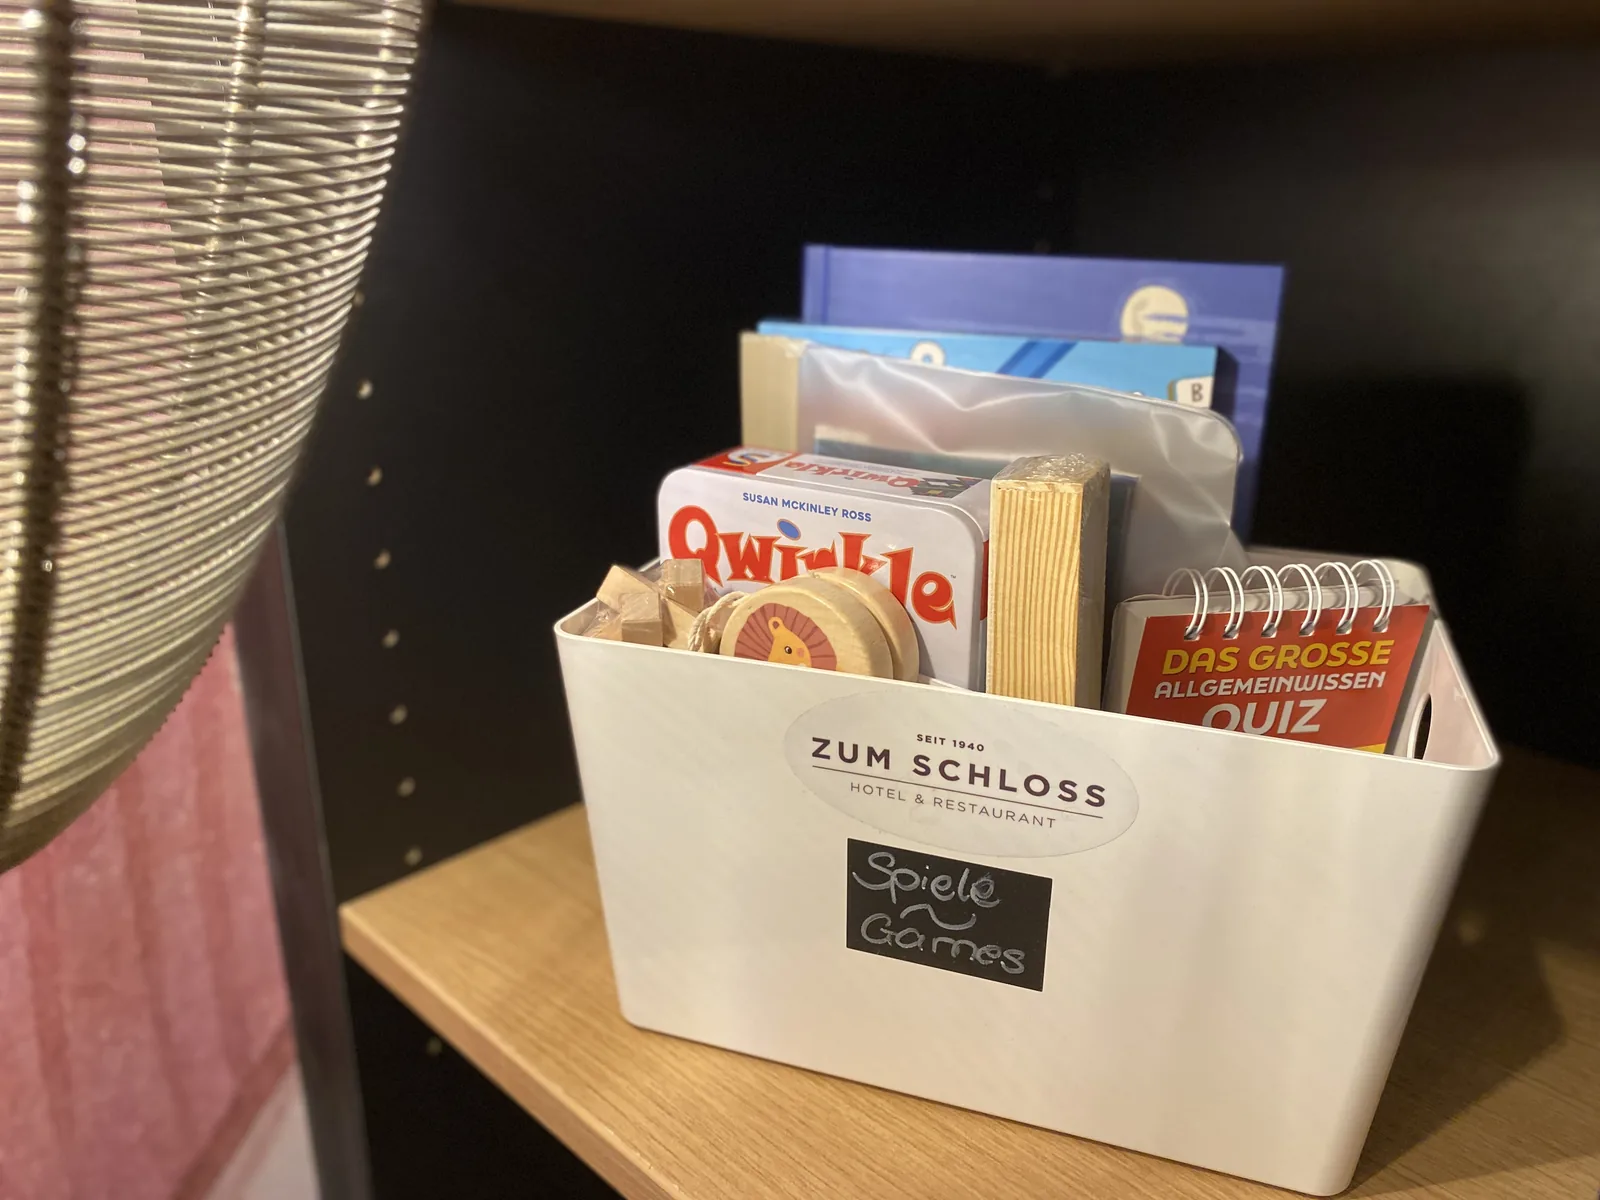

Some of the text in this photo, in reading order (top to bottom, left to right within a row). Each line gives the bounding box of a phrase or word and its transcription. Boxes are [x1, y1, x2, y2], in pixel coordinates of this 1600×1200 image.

[1191, 382, 1204, 403] B
[742, 492, 872, 522] SUSAN MCKINLEY ROSS
[667, 504, 958, 630] Qwirkle
[1162, 639, 1395, 676] DAS GROSSE
[1153, 671, 1387, 700] ALLGEMEINWISSEN
[1203, 700, 1327, 735] QUIZ
[916, 733, 985, 752] SEIT 1940
[811, 736, 1107, 808] ZUM SCHLOSS
[850, 781, 1057, 829] HOTEL & RESTAURANT
[852, 851, 1001, 908] Spiele
[860, 912, 1026, 975] Games
